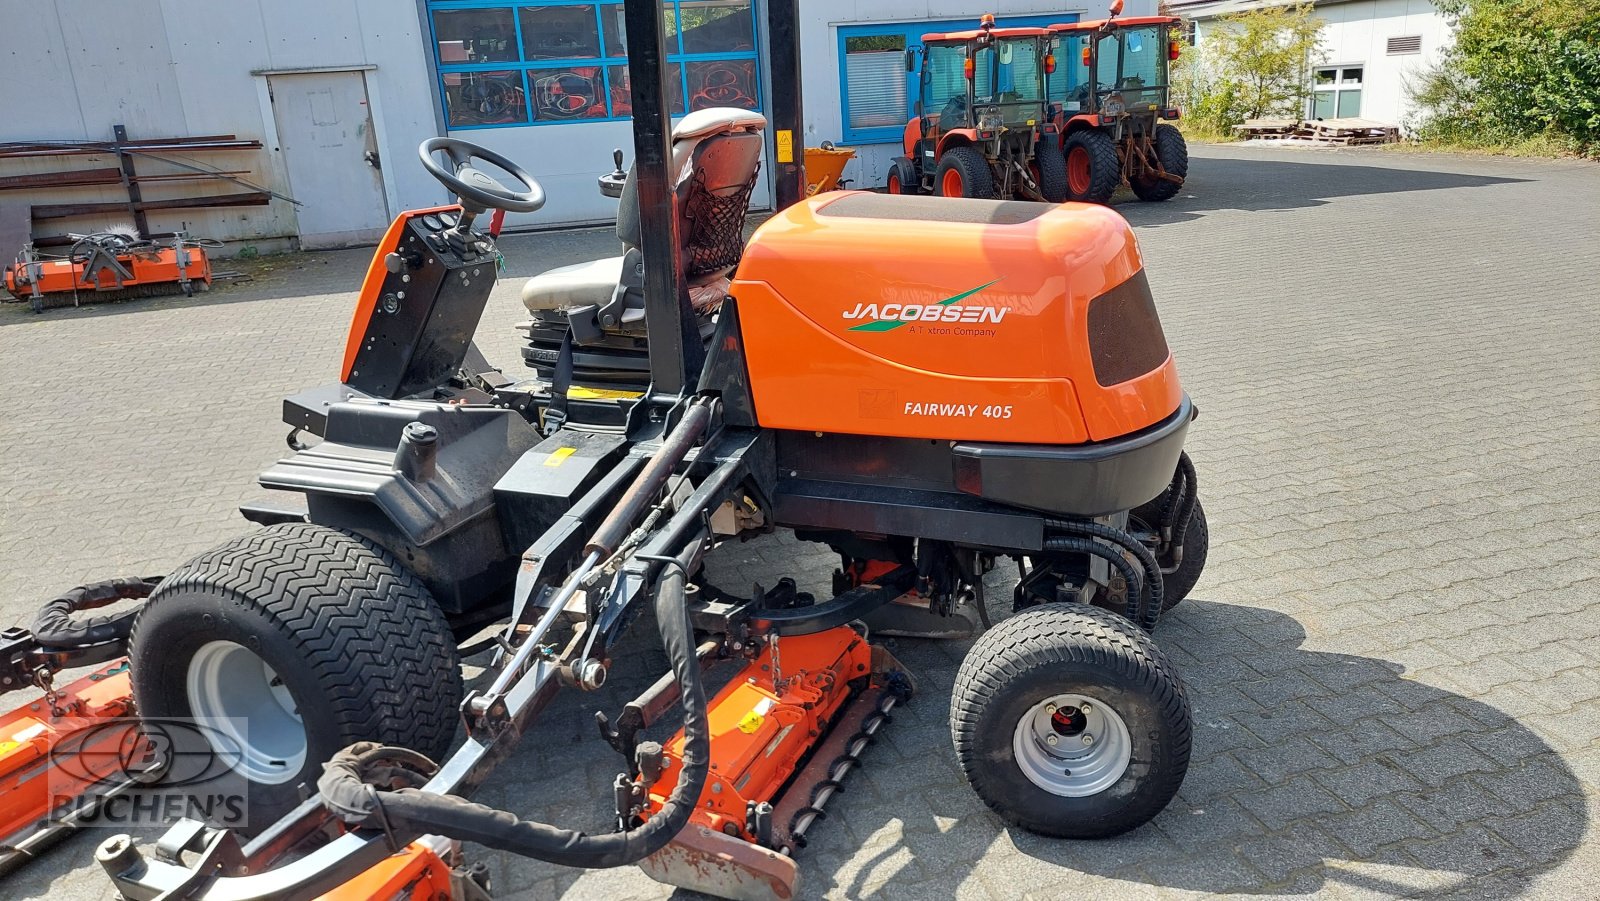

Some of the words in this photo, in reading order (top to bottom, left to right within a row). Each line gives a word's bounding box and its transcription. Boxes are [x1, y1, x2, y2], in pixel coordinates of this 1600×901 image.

[842, 303, 1008, 323] JACOBSEN
[909, 326, 915, 334] A
[918, 326, 951, 335] Txtron
[953, 327, 997, 337] Company
[904, 402, 978, 417] FAIRWAY
[982, 405, 1012, 419] 405
